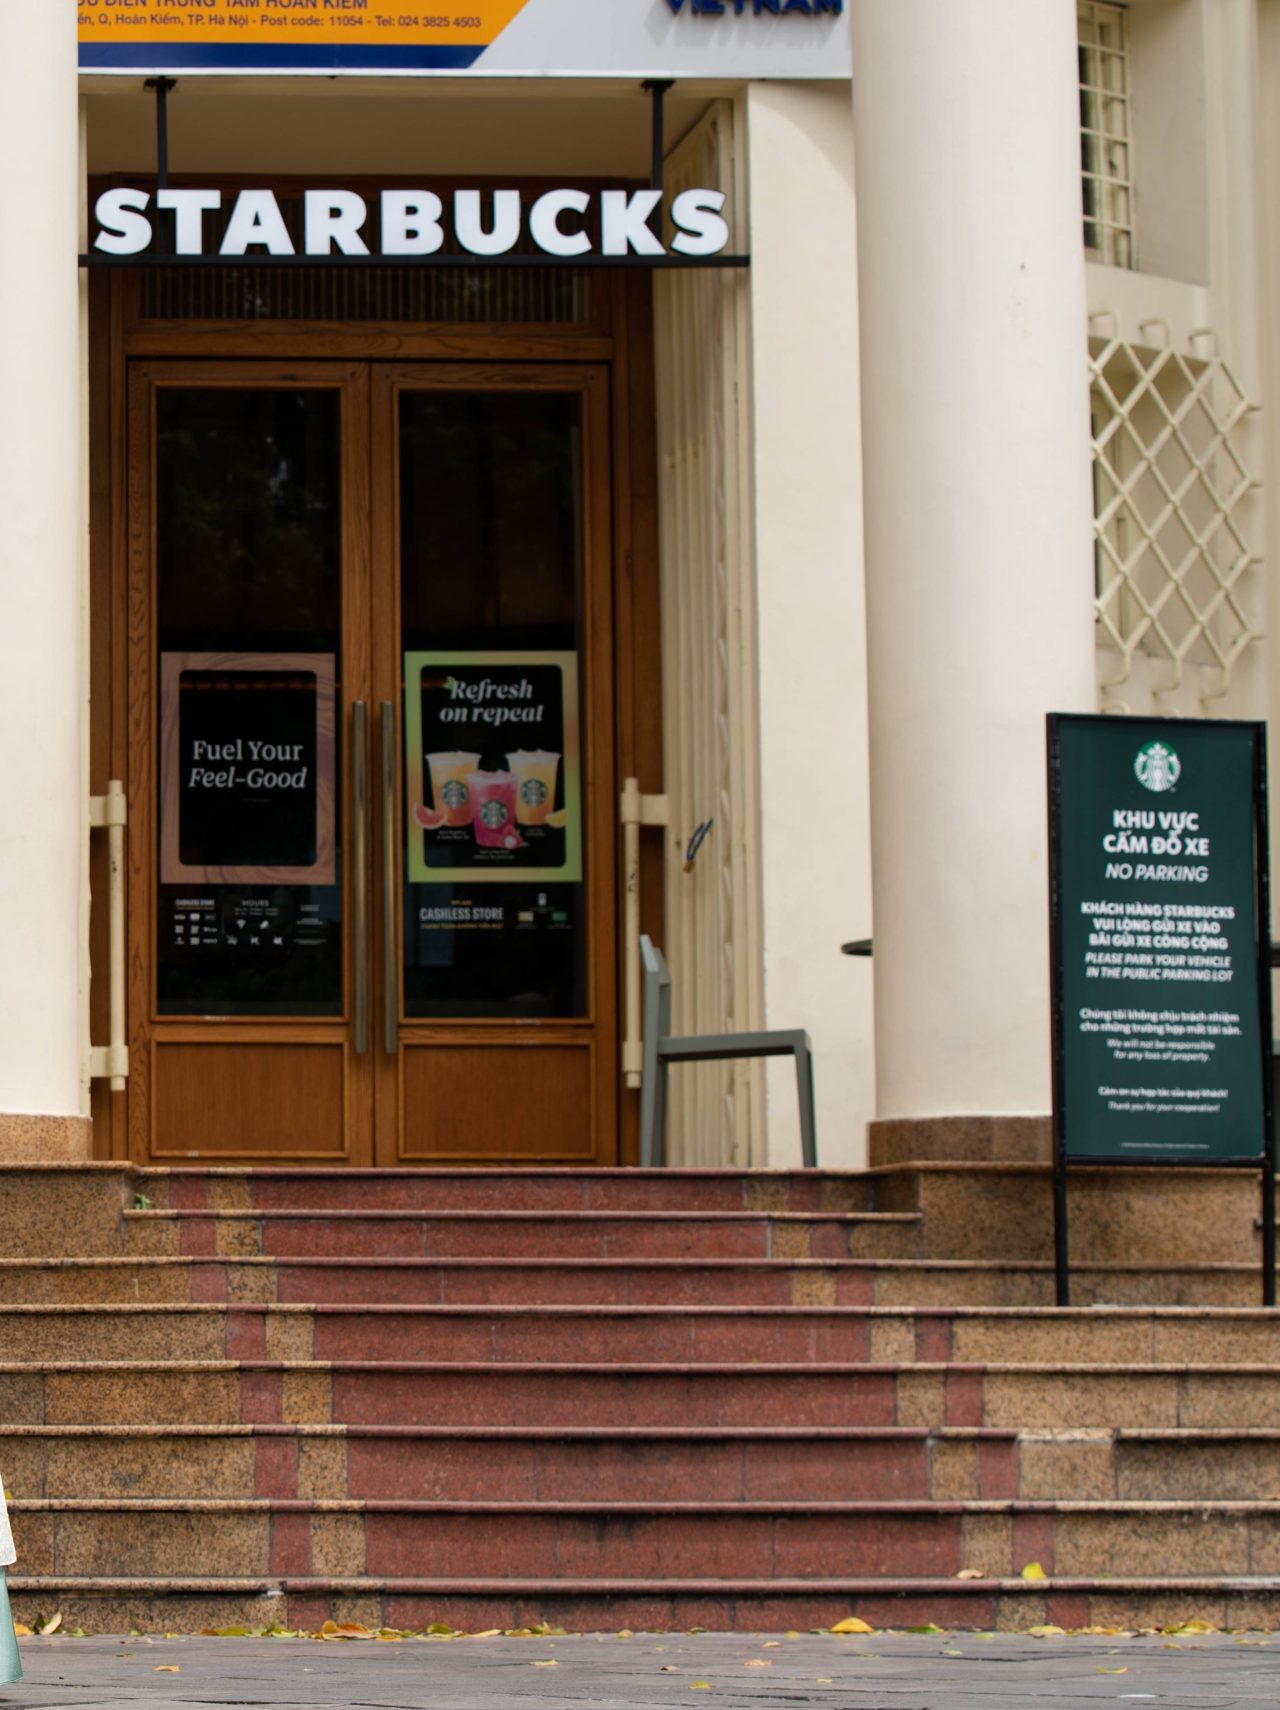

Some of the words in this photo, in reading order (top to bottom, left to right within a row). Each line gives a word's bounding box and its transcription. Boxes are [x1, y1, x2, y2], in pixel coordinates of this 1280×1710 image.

[187, 14, 206, 25] TP.
[261, 15, 288, 26] Post
[291, 14, 324, 26] code:
[329, 16, 363, 26] 11054
[375, 15, 395, 26] Tel:
[398, 16, 419, 26] 024
[93, 187, 730, 257] STARBUCKS
[449, 678, 533, 704] Refresh
[439, 706, 469, 724] on
[472, 704, 544, 727] repeat
[193, 740, 243, 762] Fuel
[248, 740, 303, 763] Your
[188, 766, 308, 790] Feel-Good
[1113, 809, 1155, 829] KHU
[1184, 837, 1210, 856] XE
[1105, 862, 1133, 880] NO
[1135, 863, 1209, 882] PARKING
[420, 907, 471, 921] CASHLESS
[472, 907, 505, 921] STORE
[1081, 901, 1124, 915] KHÁCH
[1125, 902, 1163, 917] HÀNG
[1163, 904, 1235, 919] STARBUCKS
[1093, 917, 1115, 931] VUI
[1176, 920, 1193, 933] XE
[1136, 935, 1152, 948] XE
[1085, 951, 1122, 965] PLEASE
[1123, 952, 1153, 966] PARK
[1155, 954, 1187, 967] YOUR
[1188, 955, 1232, 968] VEHICLE
[1086, 966, 1099, 978] IN
[1100, 966, 1121, 979] THE
[1122, 967, 1161, 980] PUBLIC
[1162, 968, 1211, 981] PARKING
[1212, 969, 1234, 982] LOT
